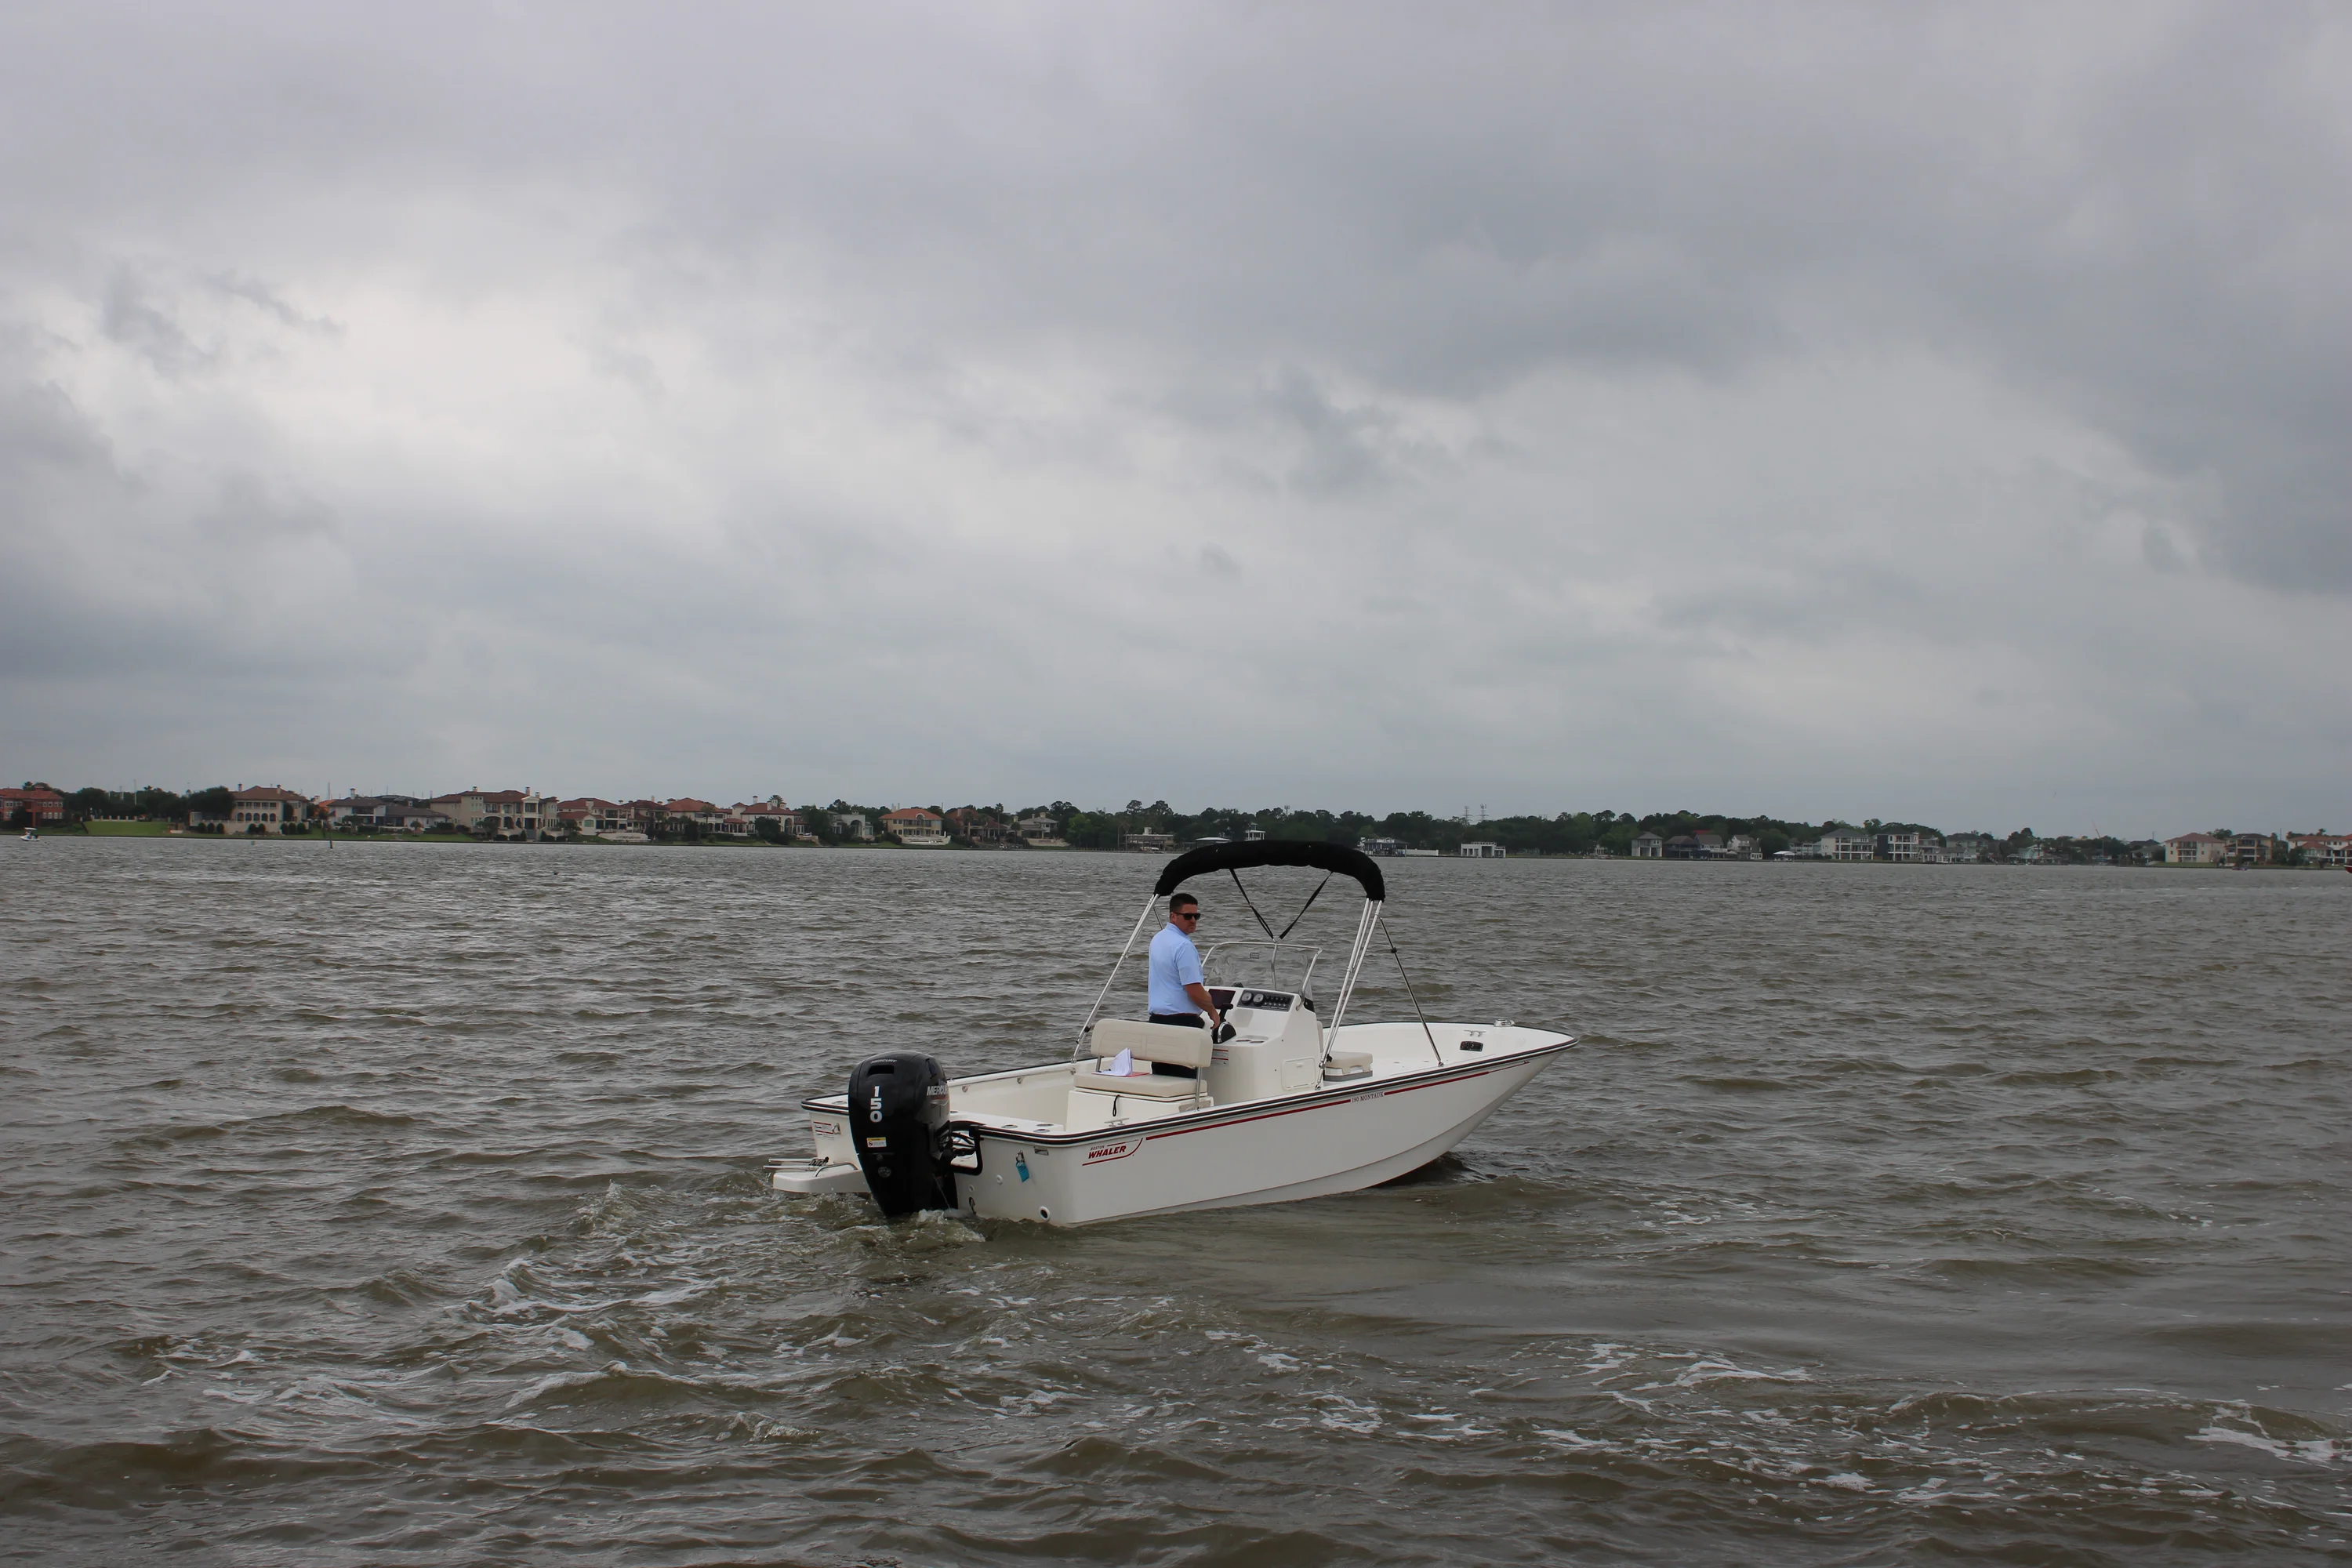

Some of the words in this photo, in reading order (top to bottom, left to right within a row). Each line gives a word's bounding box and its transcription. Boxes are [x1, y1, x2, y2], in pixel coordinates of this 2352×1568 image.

[1360, 1091, 1384, 1102] MONTAUK
[869, 1086, 883, 1123] 150
[1088, 1145, 1127, 1159] WHALER
